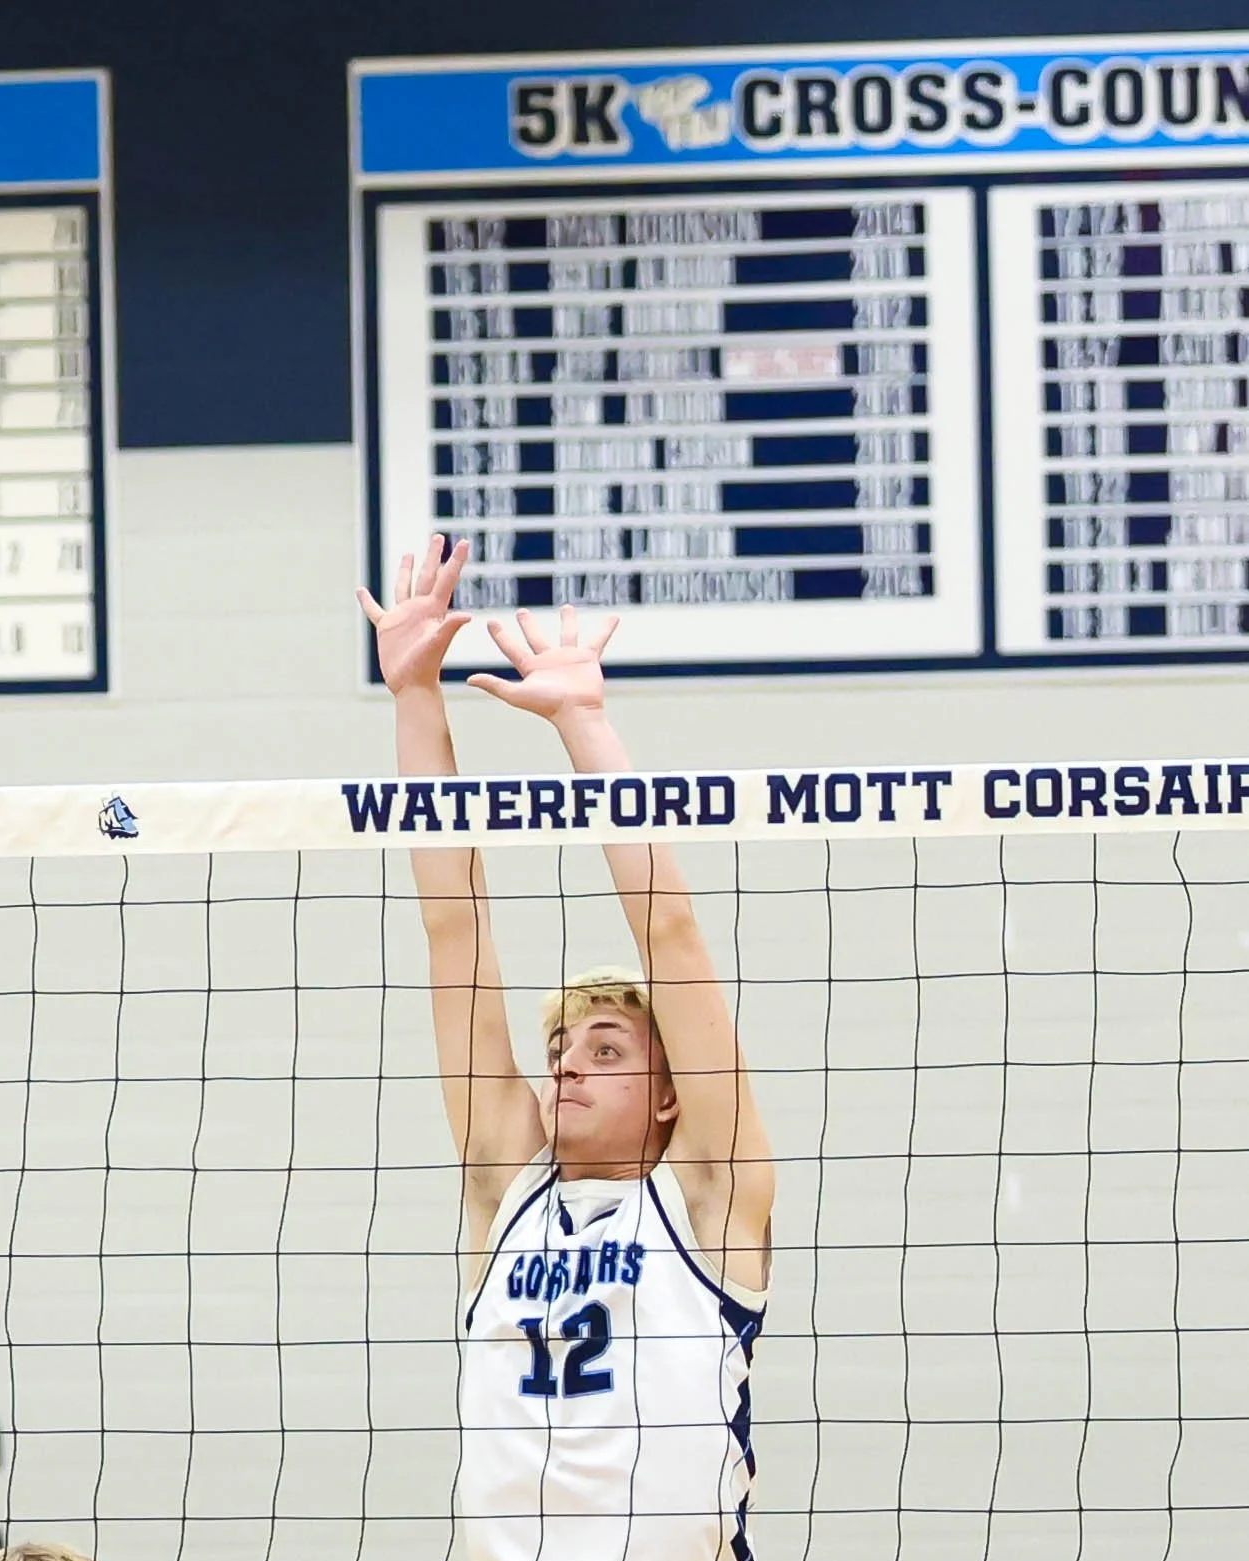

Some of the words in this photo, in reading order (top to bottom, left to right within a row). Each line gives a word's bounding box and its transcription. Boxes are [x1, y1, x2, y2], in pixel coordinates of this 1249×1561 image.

[513, 80, 625, 151] 5K
[342, 776, 736, 833] WATERFORD
[767, 771, 952, 824] MOTT
[517, 1300, 614, 1399] 12
